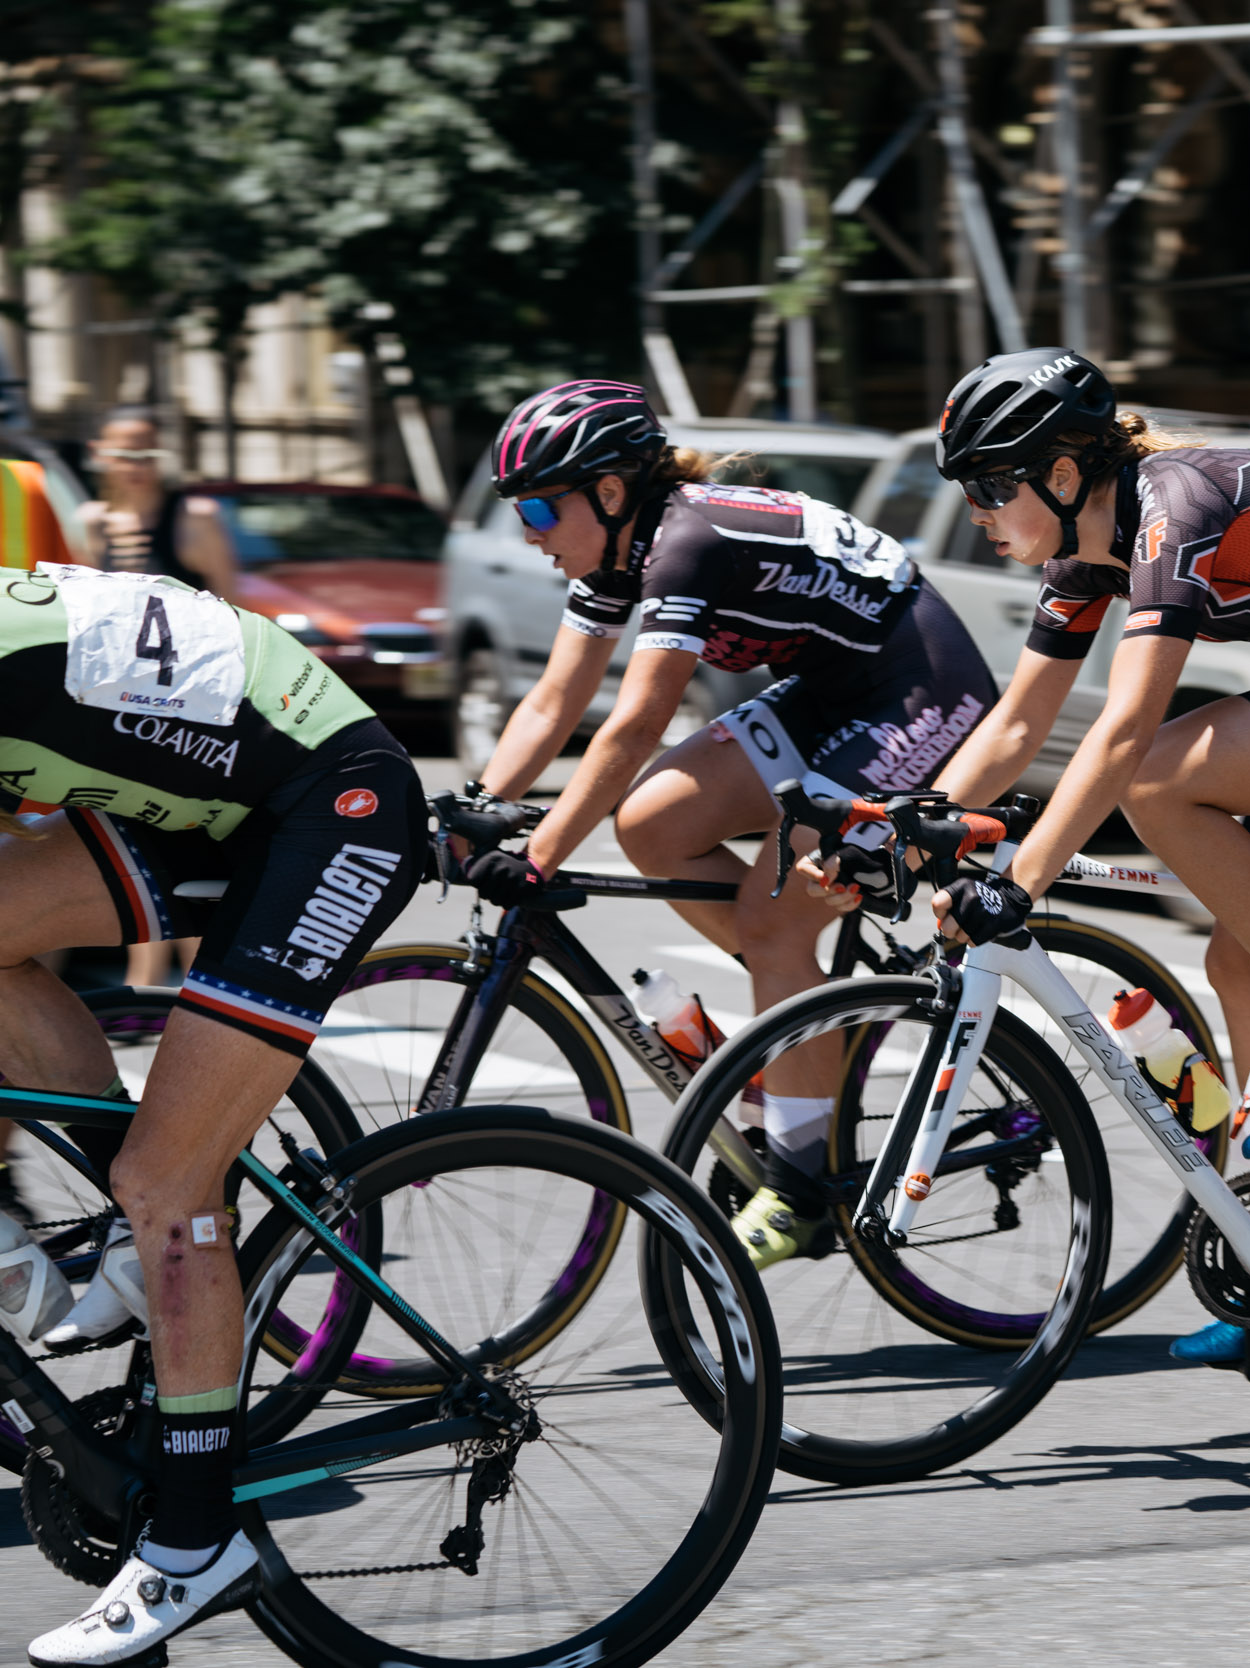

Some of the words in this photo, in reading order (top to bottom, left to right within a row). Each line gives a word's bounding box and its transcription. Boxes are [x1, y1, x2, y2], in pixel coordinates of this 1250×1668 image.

[1028, 355, 1079, 387] KASK
[136, 595, 179, 687] 4
[113, 711, 240, 778] COLAVITA
[1109, 866, 1160, 885] FEMME
[1061, 1011, 1209, 1173] PARLEE
